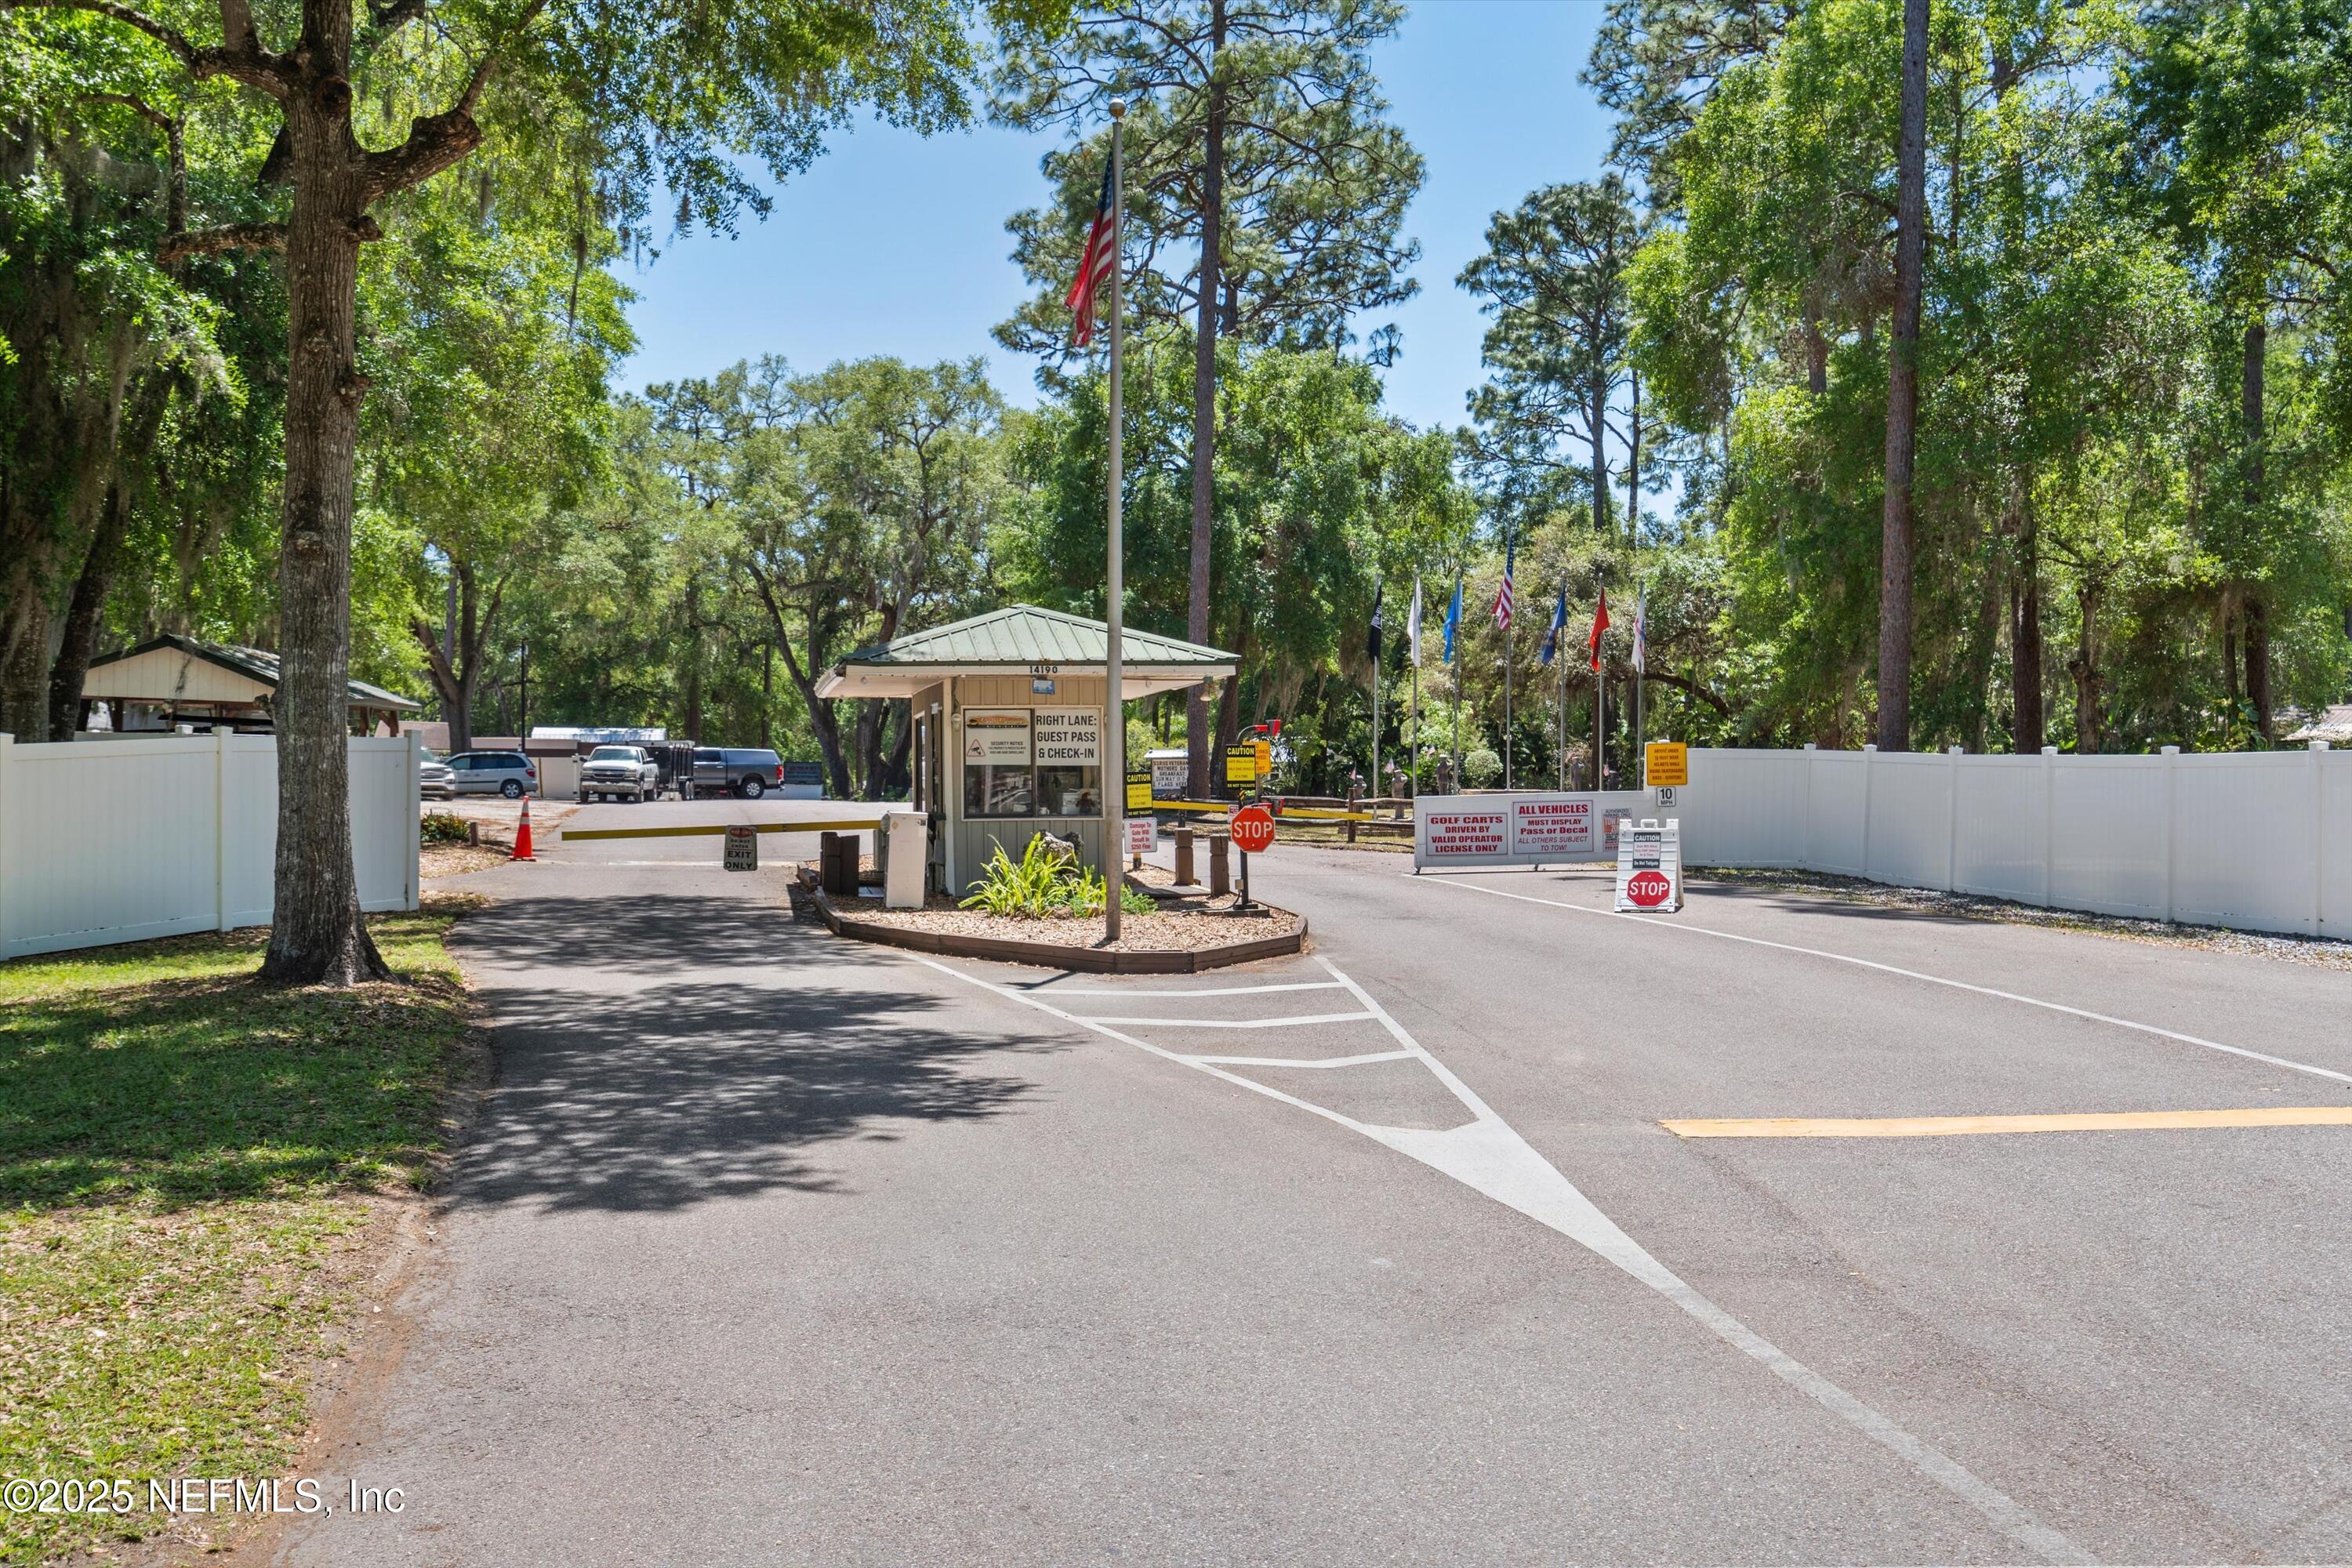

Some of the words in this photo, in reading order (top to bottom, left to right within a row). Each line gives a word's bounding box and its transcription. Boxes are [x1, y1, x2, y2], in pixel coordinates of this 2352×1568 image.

[1036, 715, 1065, 726] RIGHT
[1068, 715, 1097, 726] LANE:
[1037, 731, 1068, 742] GUEST
[1071, 731, 1096, 742] PASS
[1038, 748, 1045, 758] &
[1048, 748, 1094, 758] CHECK-IN
[1127, 774, 1151, 782] CAUTION
[1660, 788, 1672, 799] 10
[1519, 806, 1536, 814] ALL
[1538, 804, 1588, 814] VEHICLES
[1234, 821, 1272, 838] STOP
[1629, 882, 1668, 896] STOP
